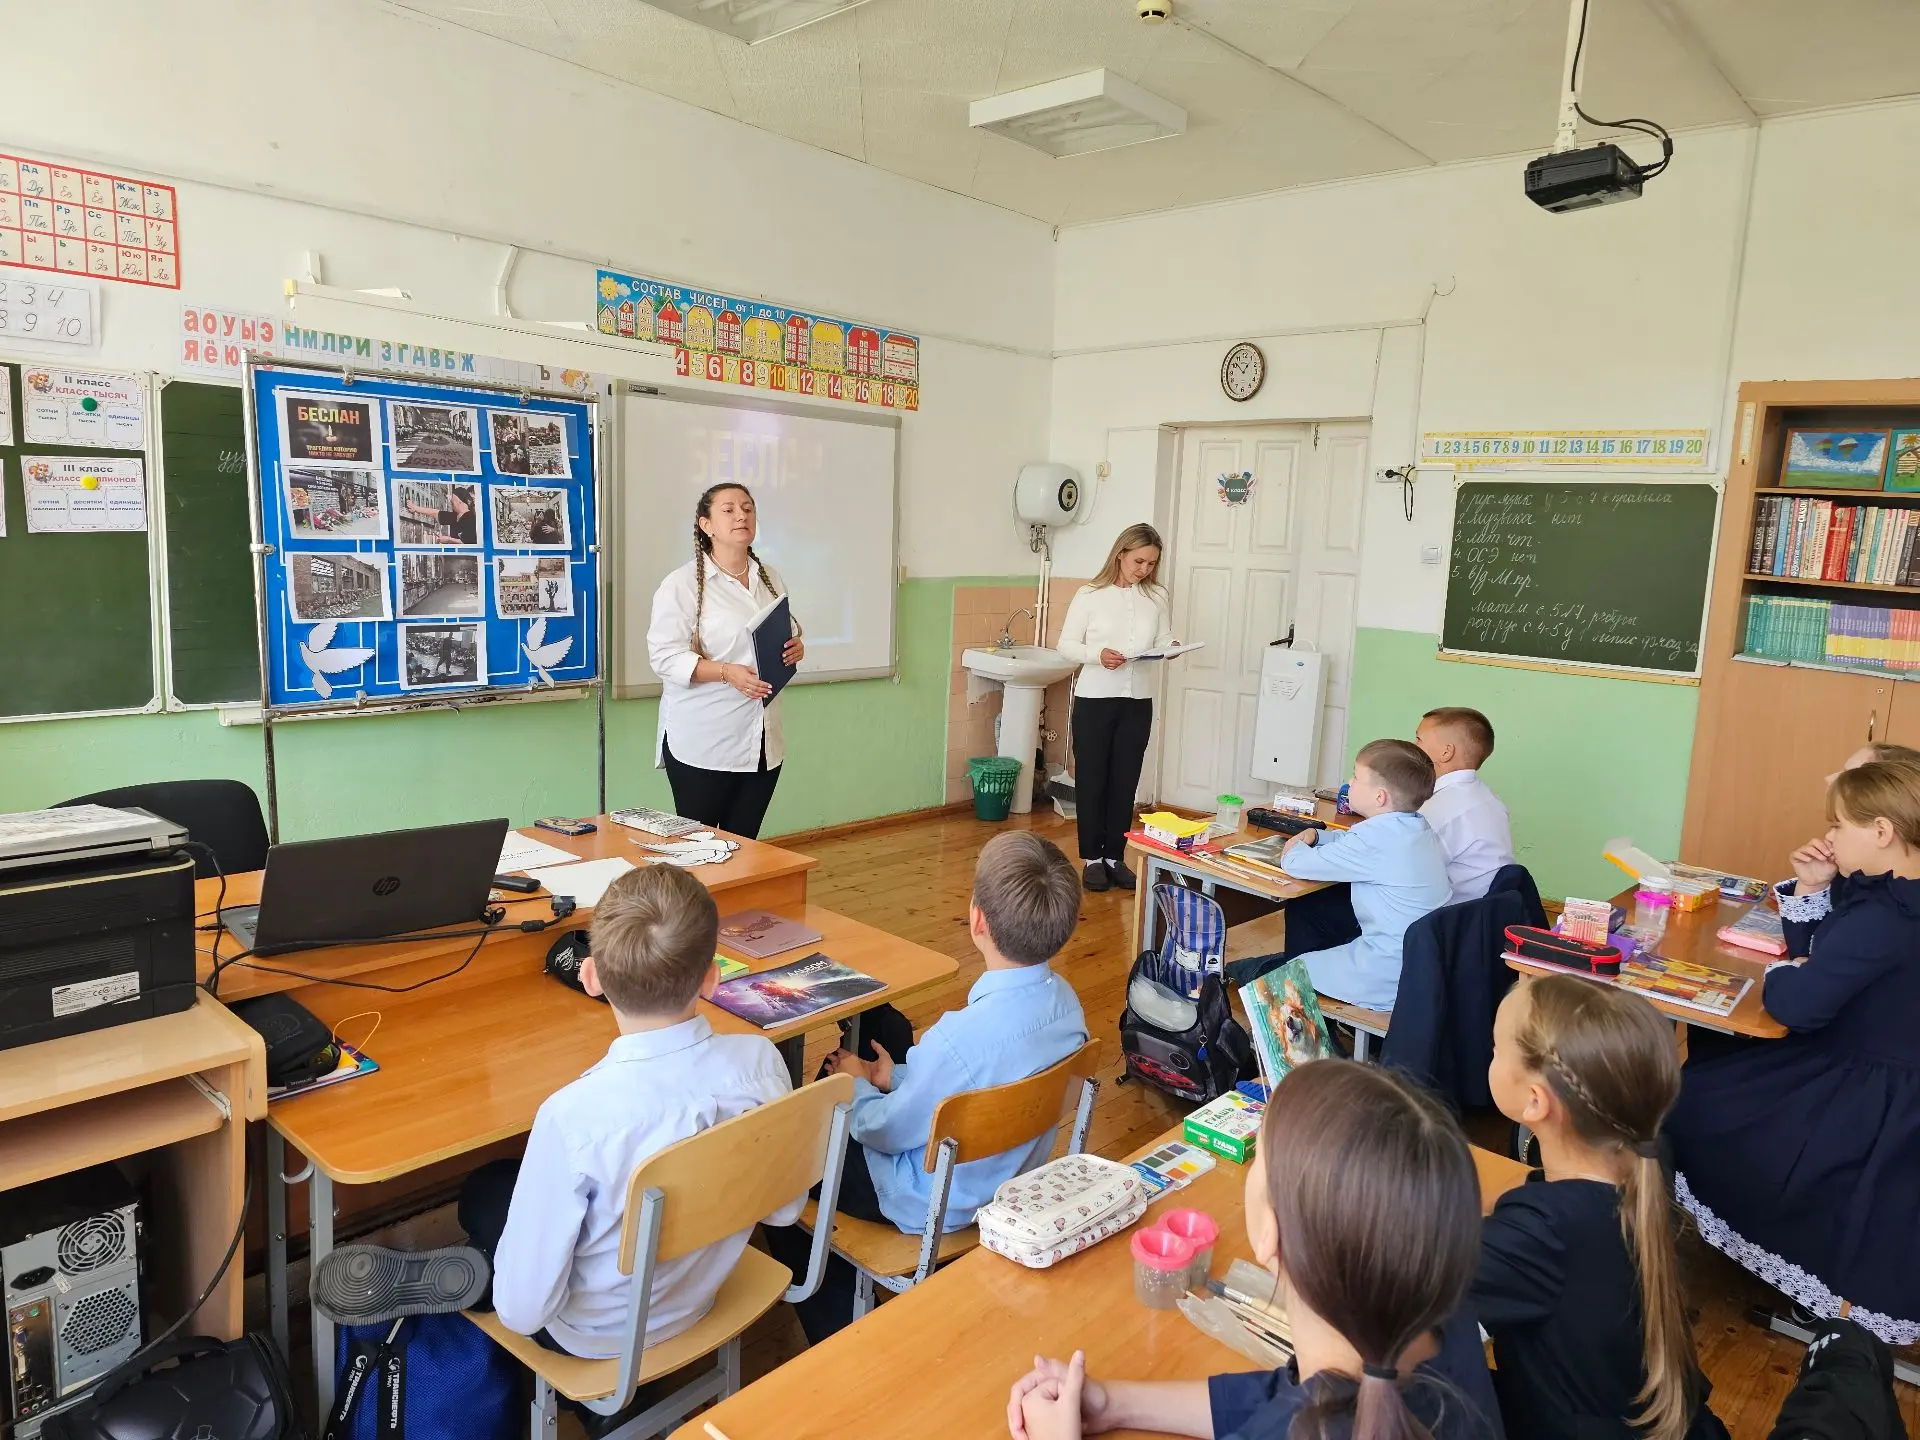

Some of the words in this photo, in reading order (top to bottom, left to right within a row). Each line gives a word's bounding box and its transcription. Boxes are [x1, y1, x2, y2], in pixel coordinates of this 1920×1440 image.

[20, 286, 36, 305] 3
[47, 288, 65, 308] 4
[632, 280, 682, 300] СОСТАВ
[689, 291, 729, 310] ЧИСЕЛ
[736, 303, 747, 313] от
[749, 304, 755, 314] 1
[758, 309, 772, 318] до
[774, 309, 785, 320] 10
[23, 312, 38, 332] 9
[57, 317, 82, 337] 10
[77, 378, 111, 388] класс
[675, 350, 687, 373] 4
[691, 352, 705, 376] 5
[709, 356, 721, 378] 6
[725, 358, 739, 381] 7
[742, 361, 754, 383] 8
[757, 363, 769, 386] 9
[770, 365, 785, 388] 10
[801, 371, 814, 394] 12
[815, 373, 828, 396] 13
[829, 375, 842, 397] 14
[843, 378, 855, 400] 15
[856, 379, 869, 401] 16
[883, 383, 895, 405] 18
[905, 387, 919, 407] 20
[55, 386, 90, 396] КЛАСС
[92, 391, 128, 400] ТЫСЯЧ
[298, 406, 360, 425] БЕСЛАН
[1434, 439, 1440, 454] 1
[1443, 439, 1451, 454] 2
[1453, 439, 1461, 454] 3
[1462, 439, 1471, 454] 4
[1472, 439, 1480, 454] 5
[1482, 439, 1491, 454] 6
[1493, 439, 1501, 454] 7
[1502, 439, 1510, 454] 8
[1511, 439, 1519, 454] 9
[1522, 439, 1535, 454] 10
[1539, 439, 1550, 454] 11
[1553, 439, 1567, 454] 12
[1569, 439, 1583, 454] 13
[1586, 439, 1600, 454] 14
[1602, 439, 1615, 454] 15
[1620, 439, 1633, 454] 16
[1636, 439, 1650, 454] 17
[1652, 439, 1666, 454] 18
[1669, 439, 1684, 454] 19
[1685, 439, 1702, 454] 20
[340, 1371, 363, 1421] ТРАНСНЕФТЬ
[390, 1373, 400, 1429] ТРАНСНЕФТЬ
